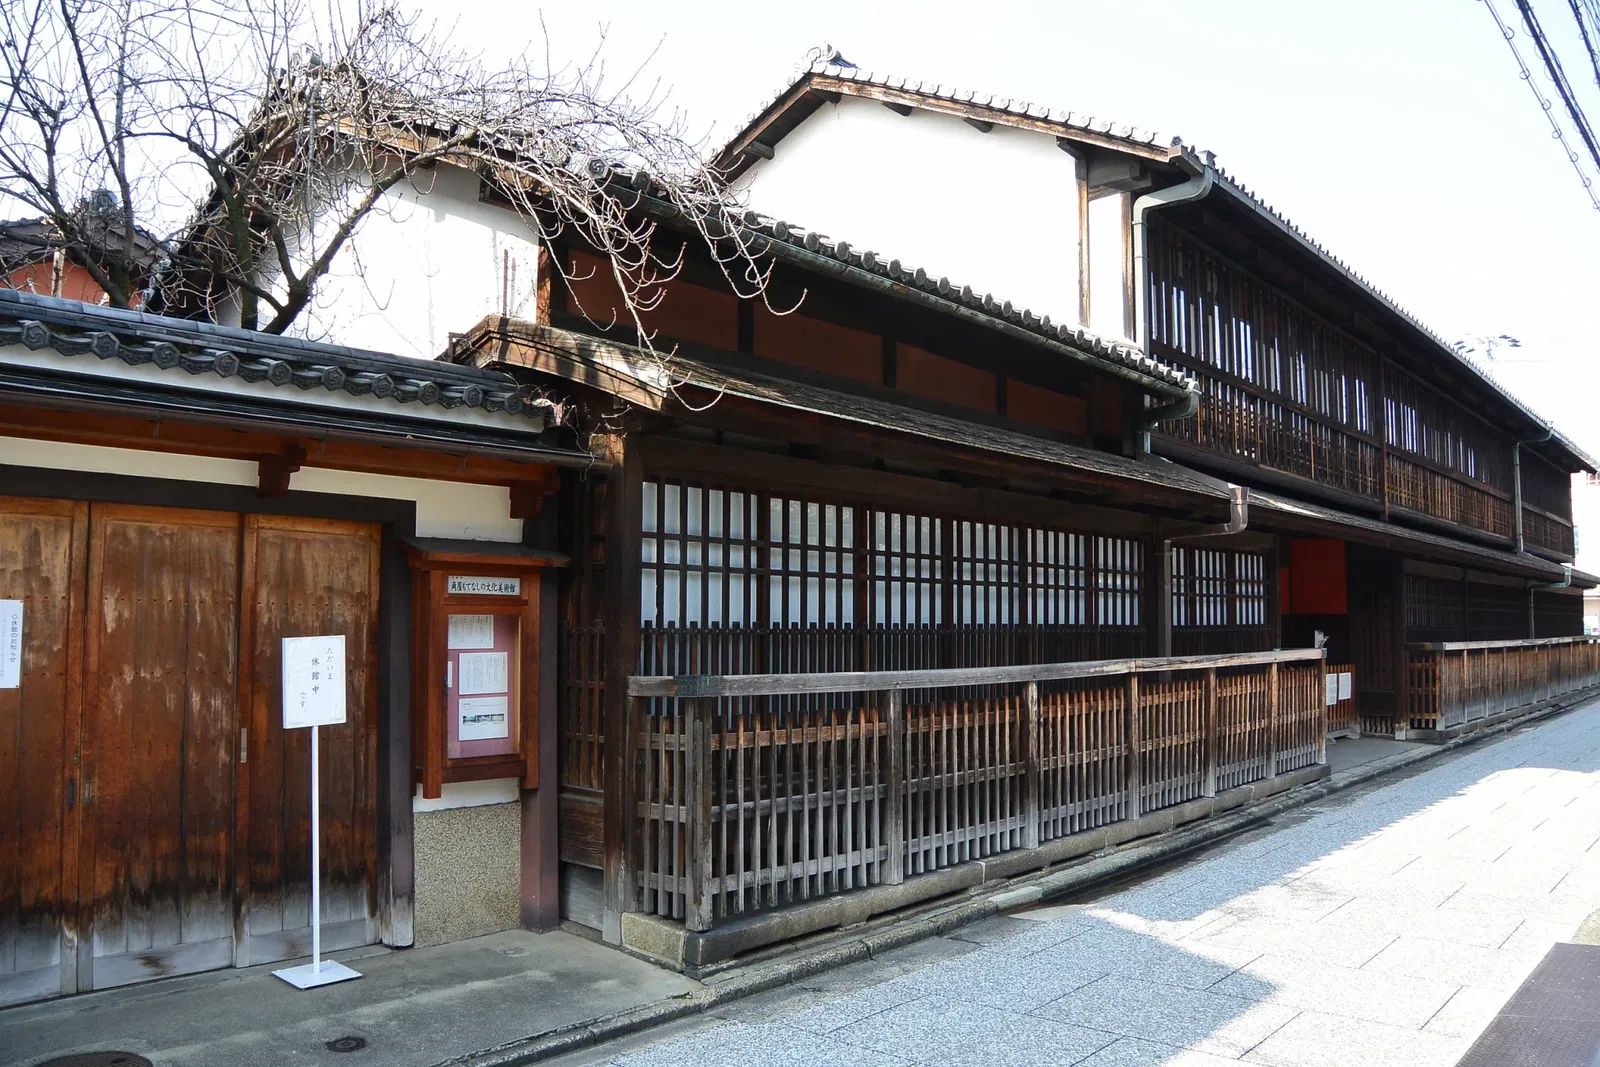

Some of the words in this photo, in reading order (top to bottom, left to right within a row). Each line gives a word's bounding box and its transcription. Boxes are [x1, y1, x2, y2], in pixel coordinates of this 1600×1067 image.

[451, 581, 516, 593] 角屋もてなしの文化美術館
[311, 657, 320, 694] 休館中
[326, 646, 334, 680] ただいま
